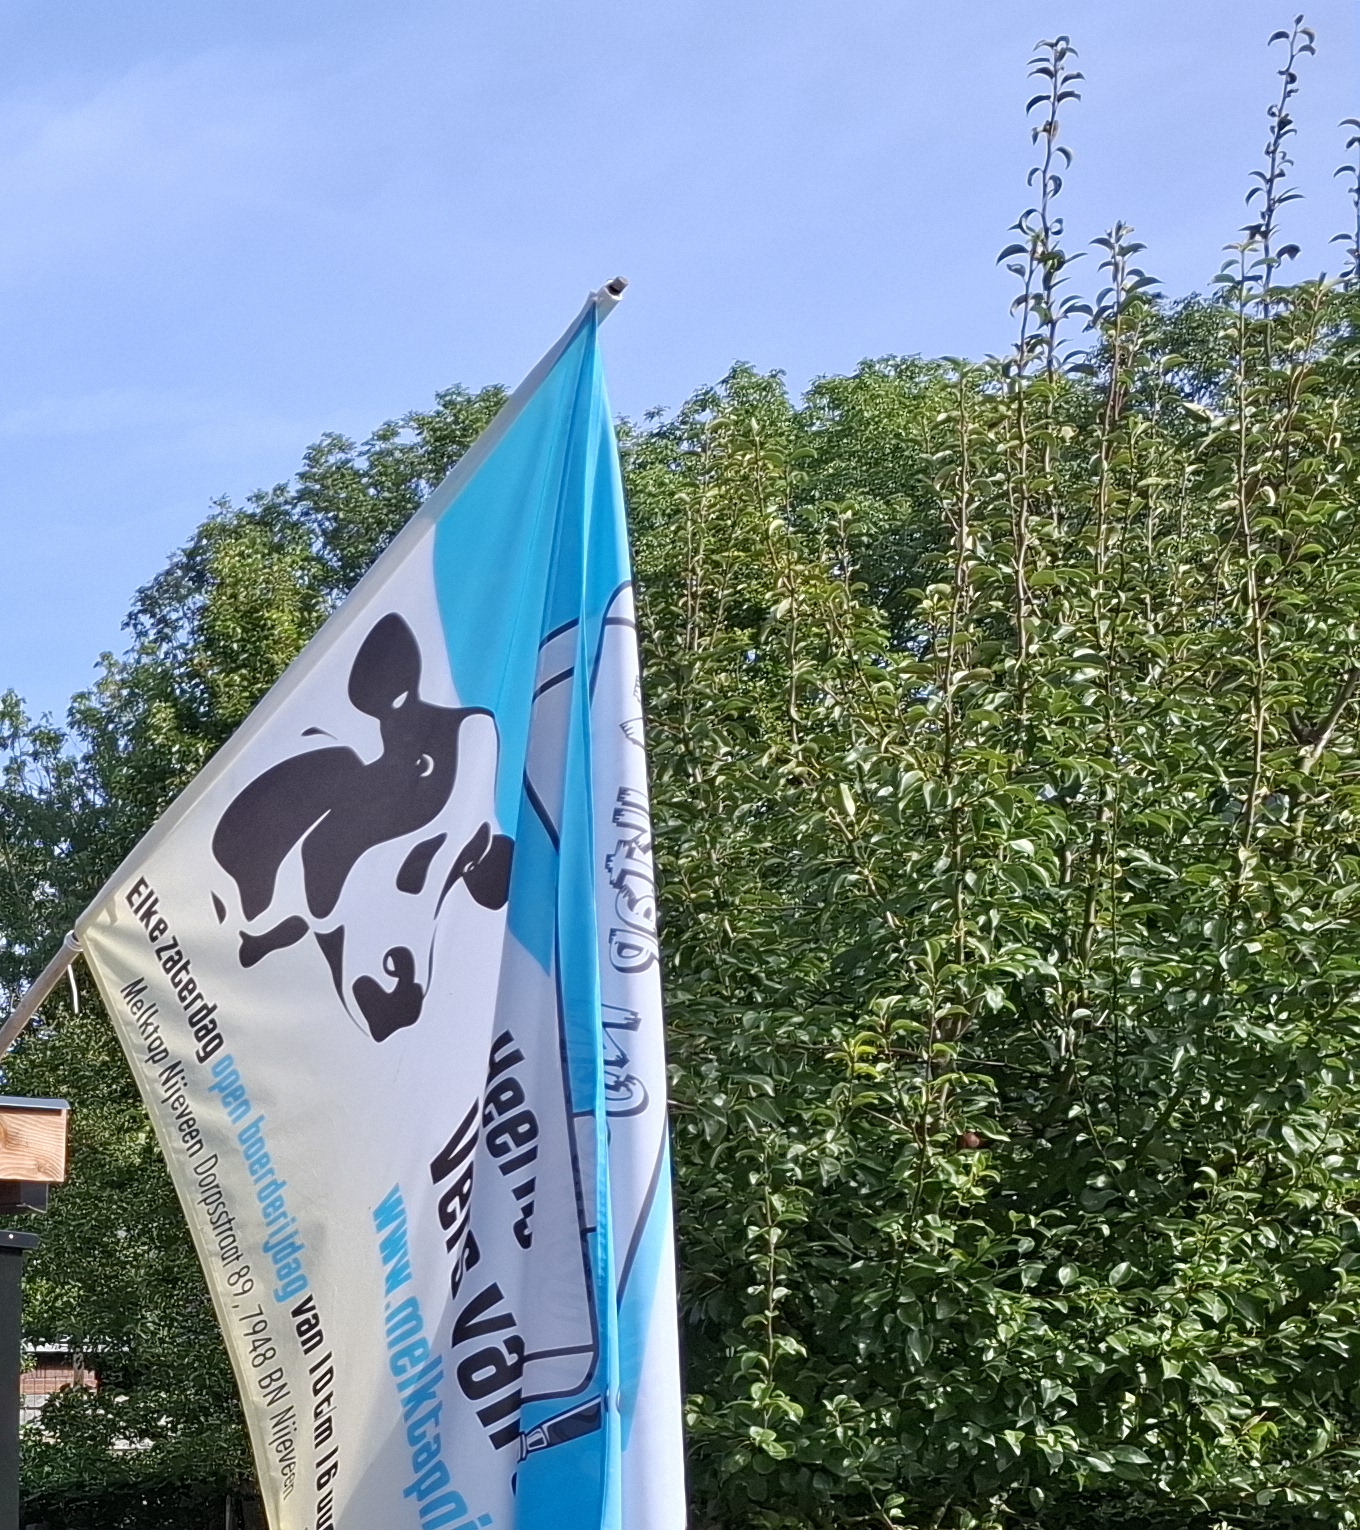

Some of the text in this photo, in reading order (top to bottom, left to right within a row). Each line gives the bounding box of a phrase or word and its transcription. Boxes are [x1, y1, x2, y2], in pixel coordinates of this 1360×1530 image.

[120, 976, 167, 1066] Melktap
[158, 1057, 205, 1159] Nijeveen
[123, 876, 168, 944] Elke
[154, 932, 225, 1065] zaterdag
[211, 1053, 251, 1127] open
[237, 1116, 310, 1303] boerderijdag
[291, 1294, 323, 1356] van
[315, 1445, 339, 1491] 16
[192, 1153, 242, 1267] Dorpsstraat
[257, 1366, 291, 1407] BN
[268, 1404, 298, 1501] Nijeveen
